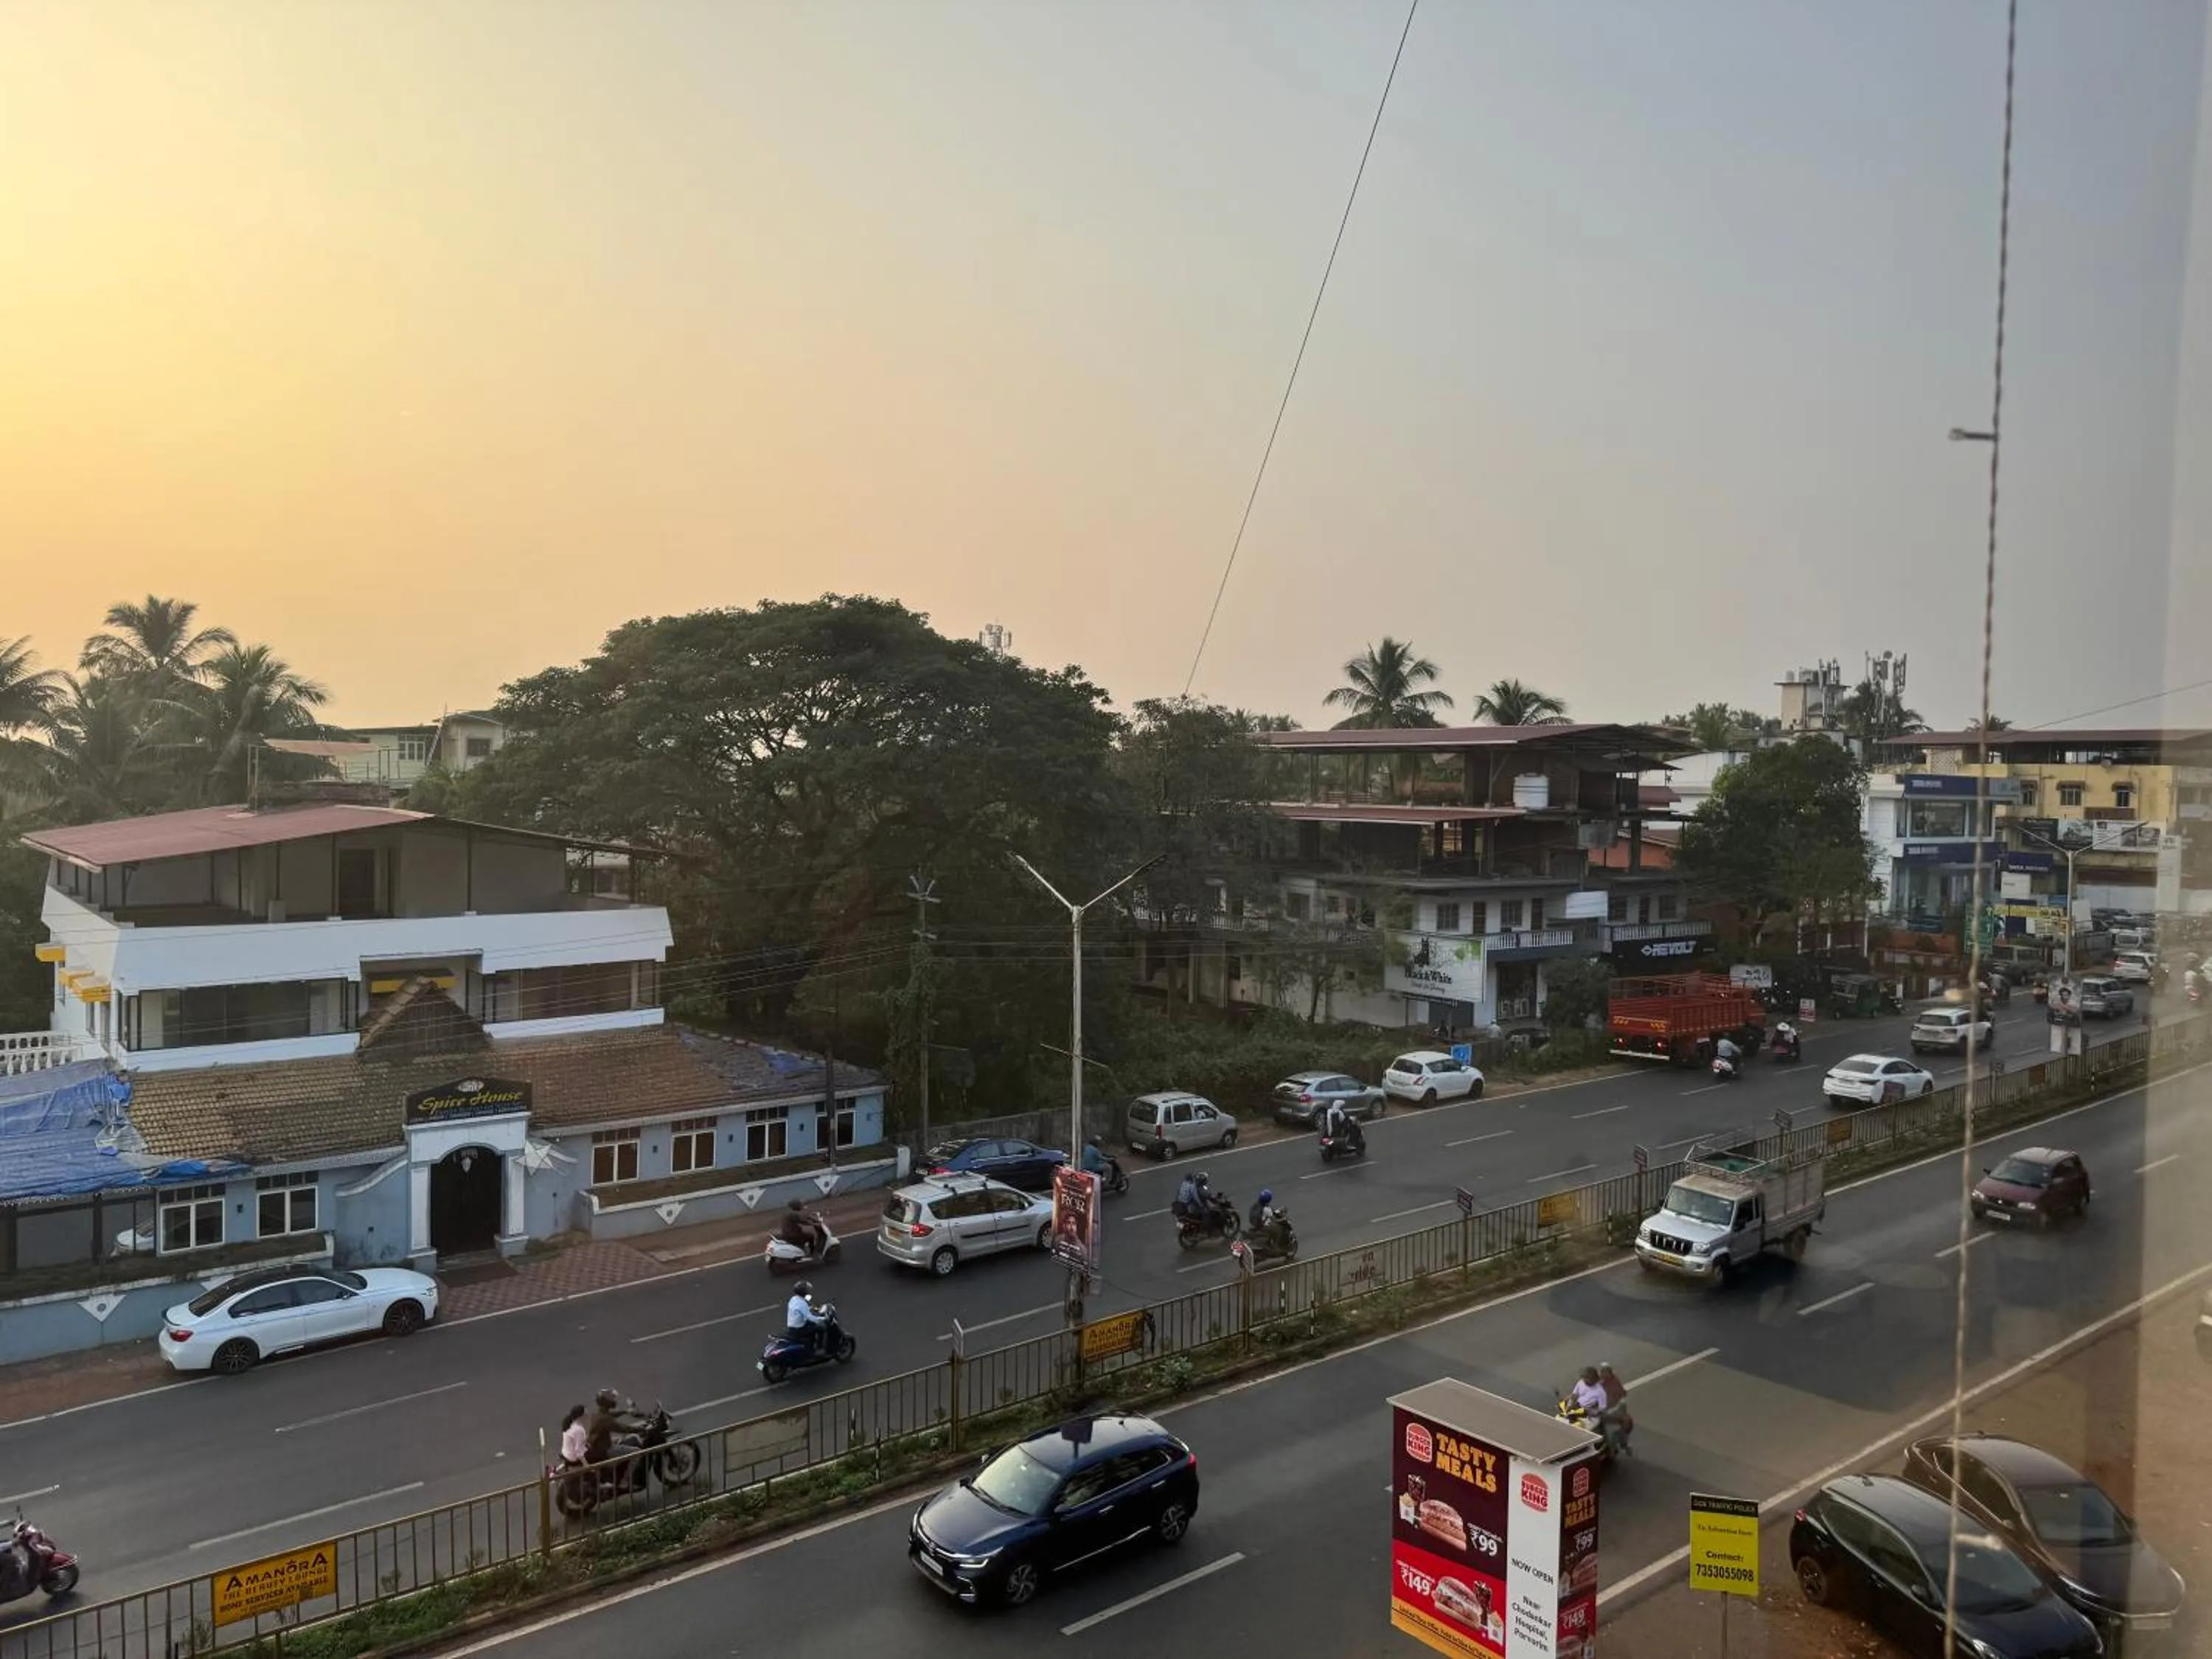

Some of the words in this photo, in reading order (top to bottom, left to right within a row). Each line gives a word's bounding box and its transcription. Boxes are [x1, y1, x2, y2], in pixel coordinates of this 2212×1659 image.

[418, 1096, 467, 1116] Spice
[470, 1091, 524, 1106] House
[1408, 1439, 1431, 1456] KING
[1436, 1433, 1496, 1472] TASTY
[1436, 1450, 1497, 1493] MEALS
[1521, 1489, 1548, 1507] KING
[226, 1551, 328, 1592] AMANORA
[1512, 1557, 1531, 1573] NOW
[1532, 1568, 1554, 1585] OPEN
[1695, 1563, 1755, 1582] 7353055098
